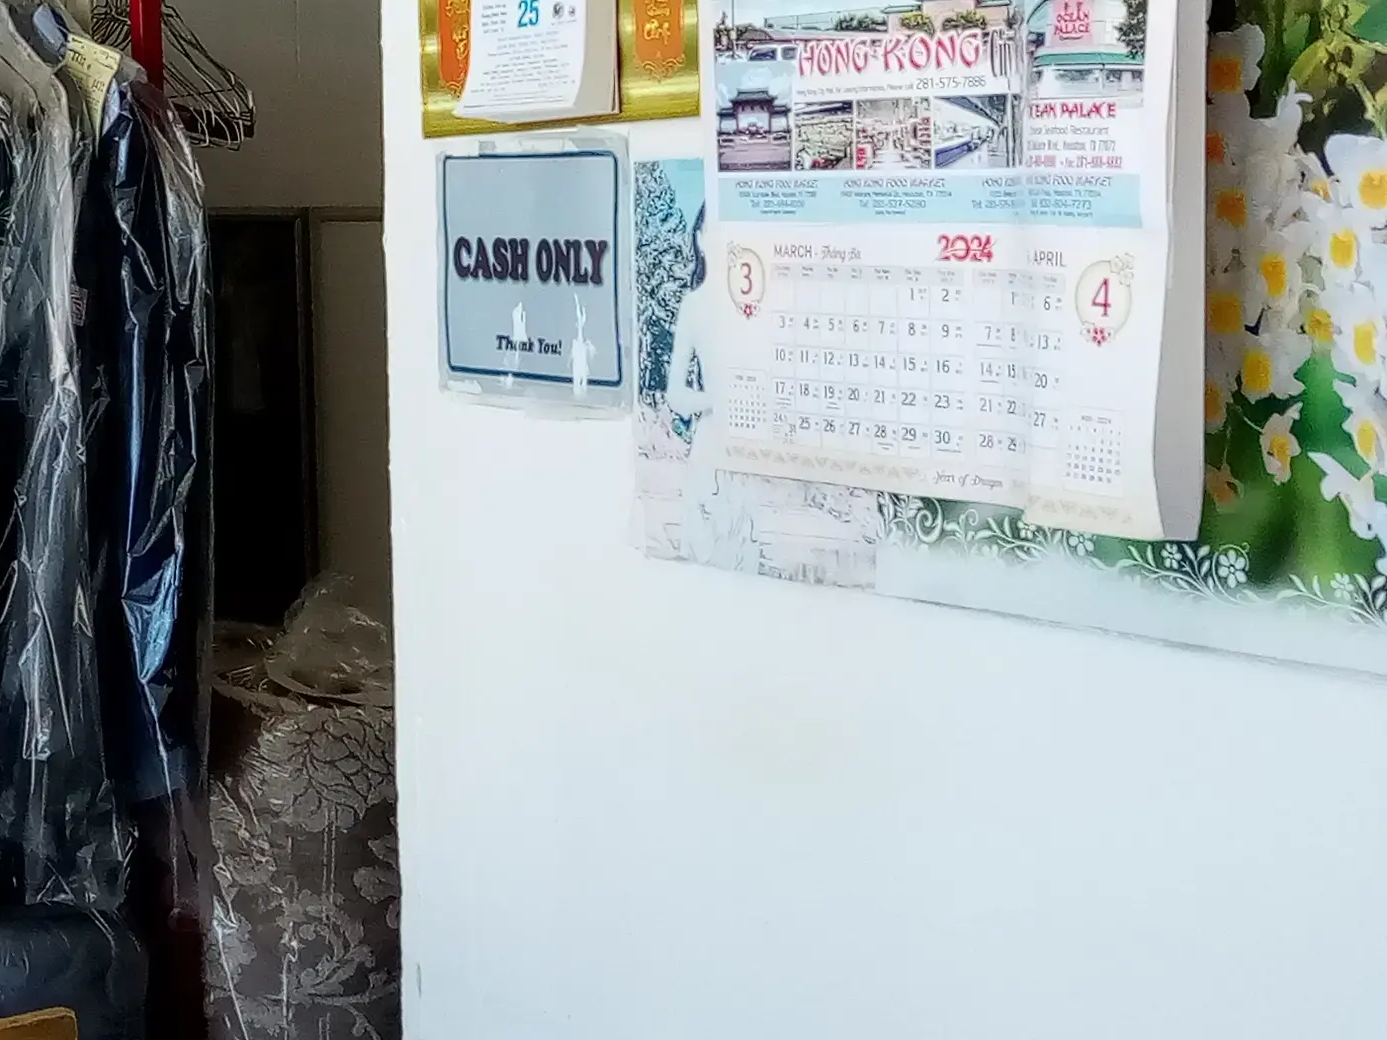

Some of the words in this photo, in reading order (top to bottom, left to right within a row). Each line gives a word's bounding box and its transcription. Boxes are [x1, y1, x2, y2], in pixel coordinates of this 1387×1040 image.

[797, 37, 869, 77] HONG
[879, 30, 984, 71] KONG
[1060, 102, 1117, 118] PALACE
[774, 245, 812, 258] MARCH
[938, 234, 995, 262] 2024
[1033, 251, 1066, 267] APRIL
[453, 236, 529, 281] CASH
[536, 238, 609, 286] ONLY
[740, 263, 752, 295] 3
[909, 288, 914, 300] 1
[942, 289, 949, 302] 2
[1044, 296, 1051, 310] 6
[1091, 277, 1111, 316] 4
[779, 317, 785, 329] 3
[803, 318, 810, 330] 4
[828, 318, 835, 330] 5
[853, 320, 860, 332] 6
[879, 321, 885, 334] 7
[908, 323, 916, 336] 8
[942, 324, 949, 338] 9
[985, 327, 992, 340] 7
[1037, 335, 1049, 350] 13
[537, 338, 563, 356] You!
[775, 349, 786, 361] 10
[800, 350, 809, 362] 11
[823, 352, 834, 365] 12
[849, 354, 859, 366] 13
[874, 355, 885, 368] 14
[903, 358, 916, 371] 15
[936, 360, 950, 373] 16
[1034, 373, 1048, 388] 20
[775, 382, 786, 395] 17
[799, 383, 810, 396] 18
[824, 386, 835, 399] 19
[848, 388, 859, 401] 20
[874, 390, 885, 403] 21
[901, 393, 916, 406] 22
[934, 395, 950, 409] 23
[979, 399, 992, 412] 21
[1033, 412, 1046, 427] 27
[799, 417, 810, 429] 25
[824, 419, 835, 432] 26
[848, 422, 860, 435] 27
[874, 424, 887, 437] 28
[901, 428, 916, 441] 29
[935, 431, 950, 444] 30
[979, 434, 994, 448] 28
